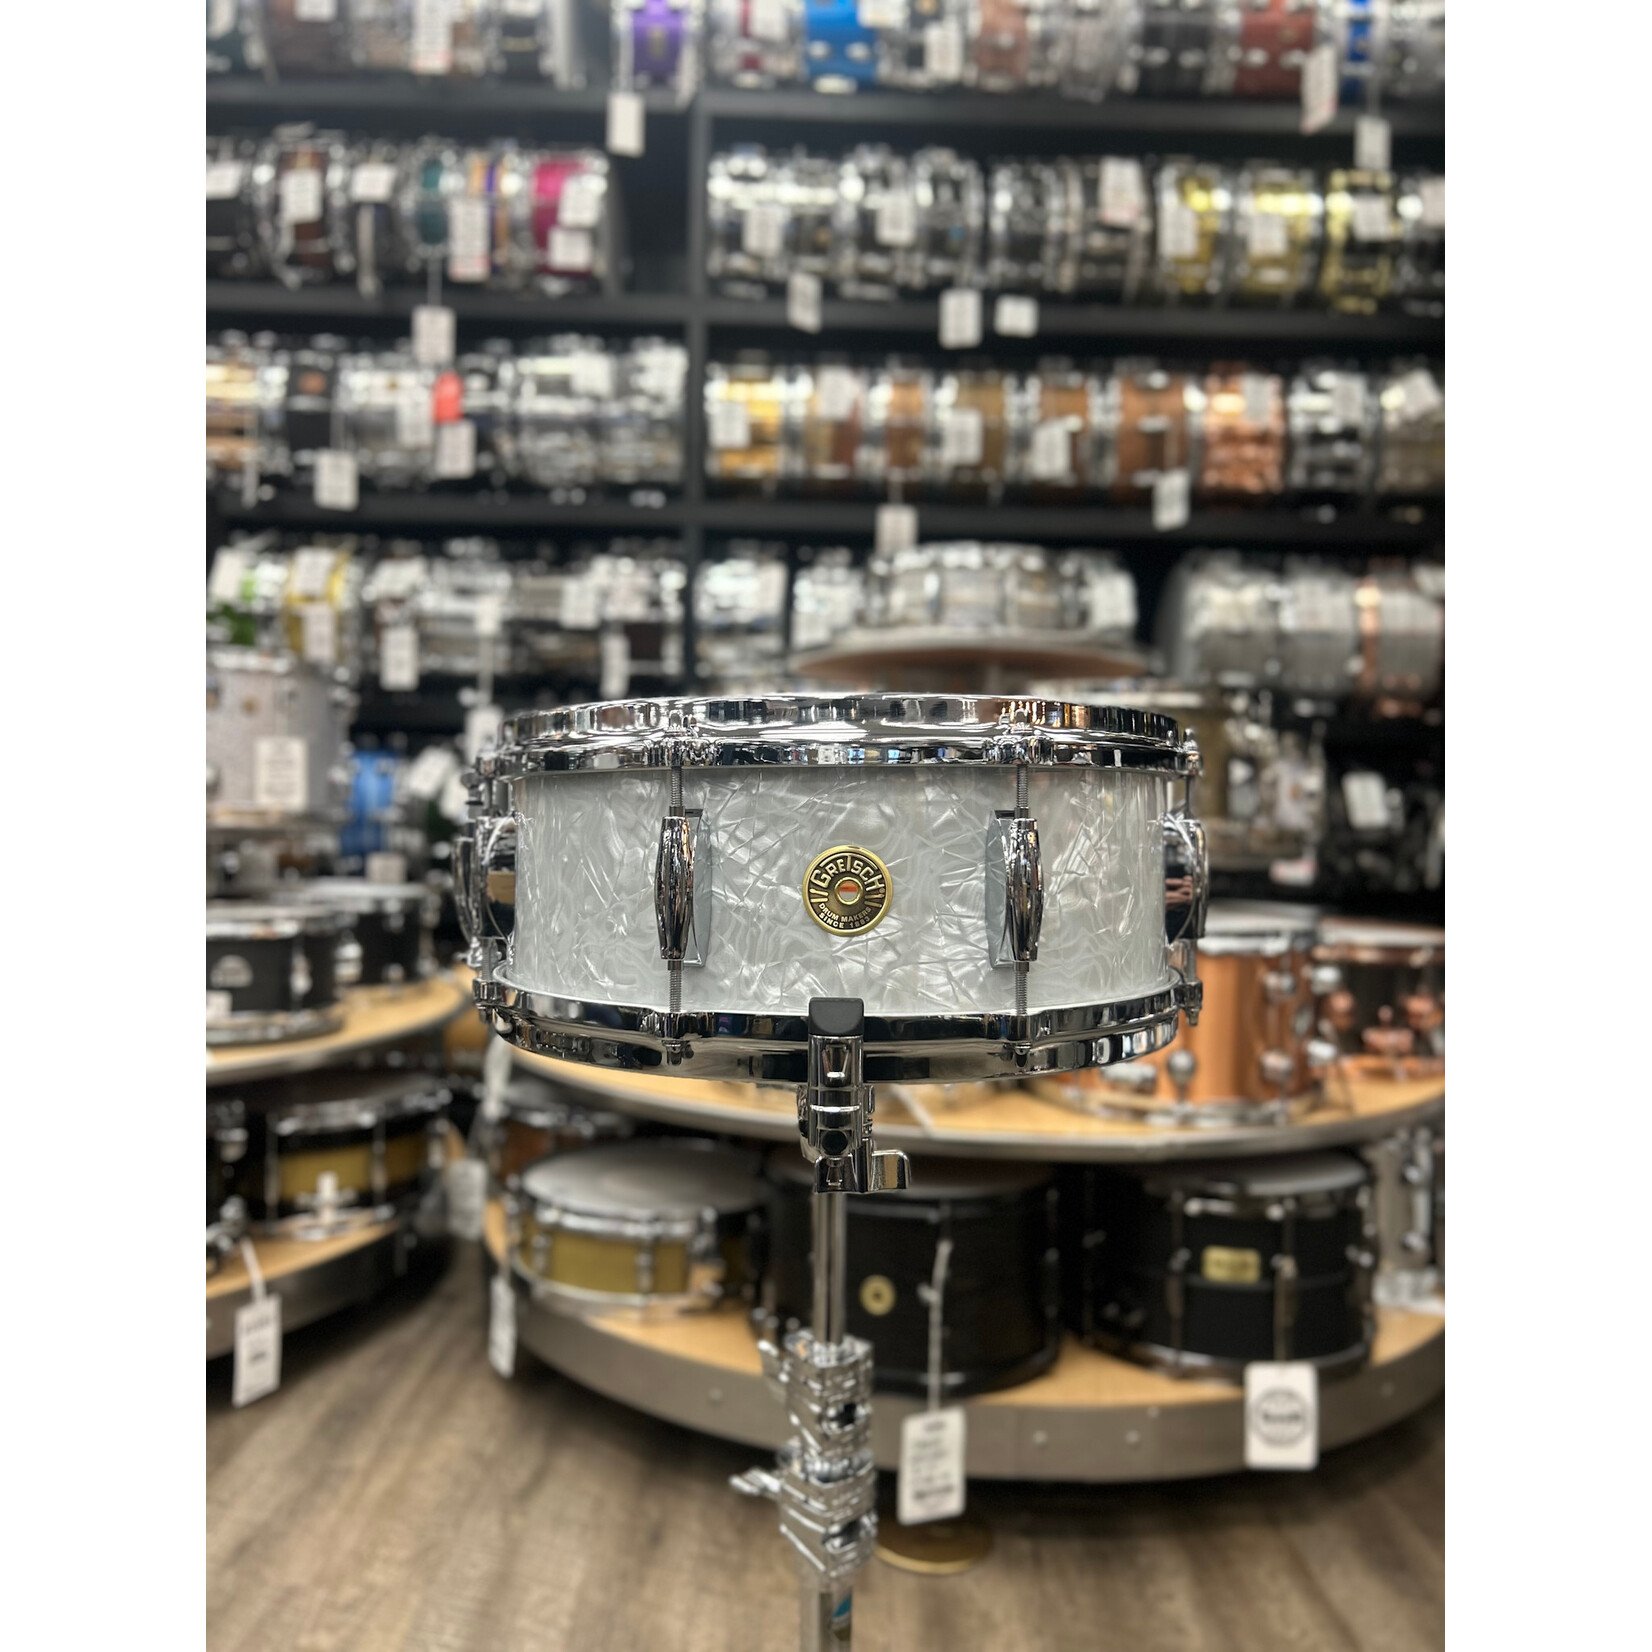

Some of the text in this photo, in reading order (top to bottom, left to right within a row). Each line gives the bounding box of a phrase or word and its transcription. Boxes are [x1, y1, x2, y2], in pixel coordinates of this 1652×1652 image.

[810, 853, 885, 891] GRETSCH
[818, 902, 872, 922] DRUM MAKERS
[818, 913, 870, 929] SINCE 1883
